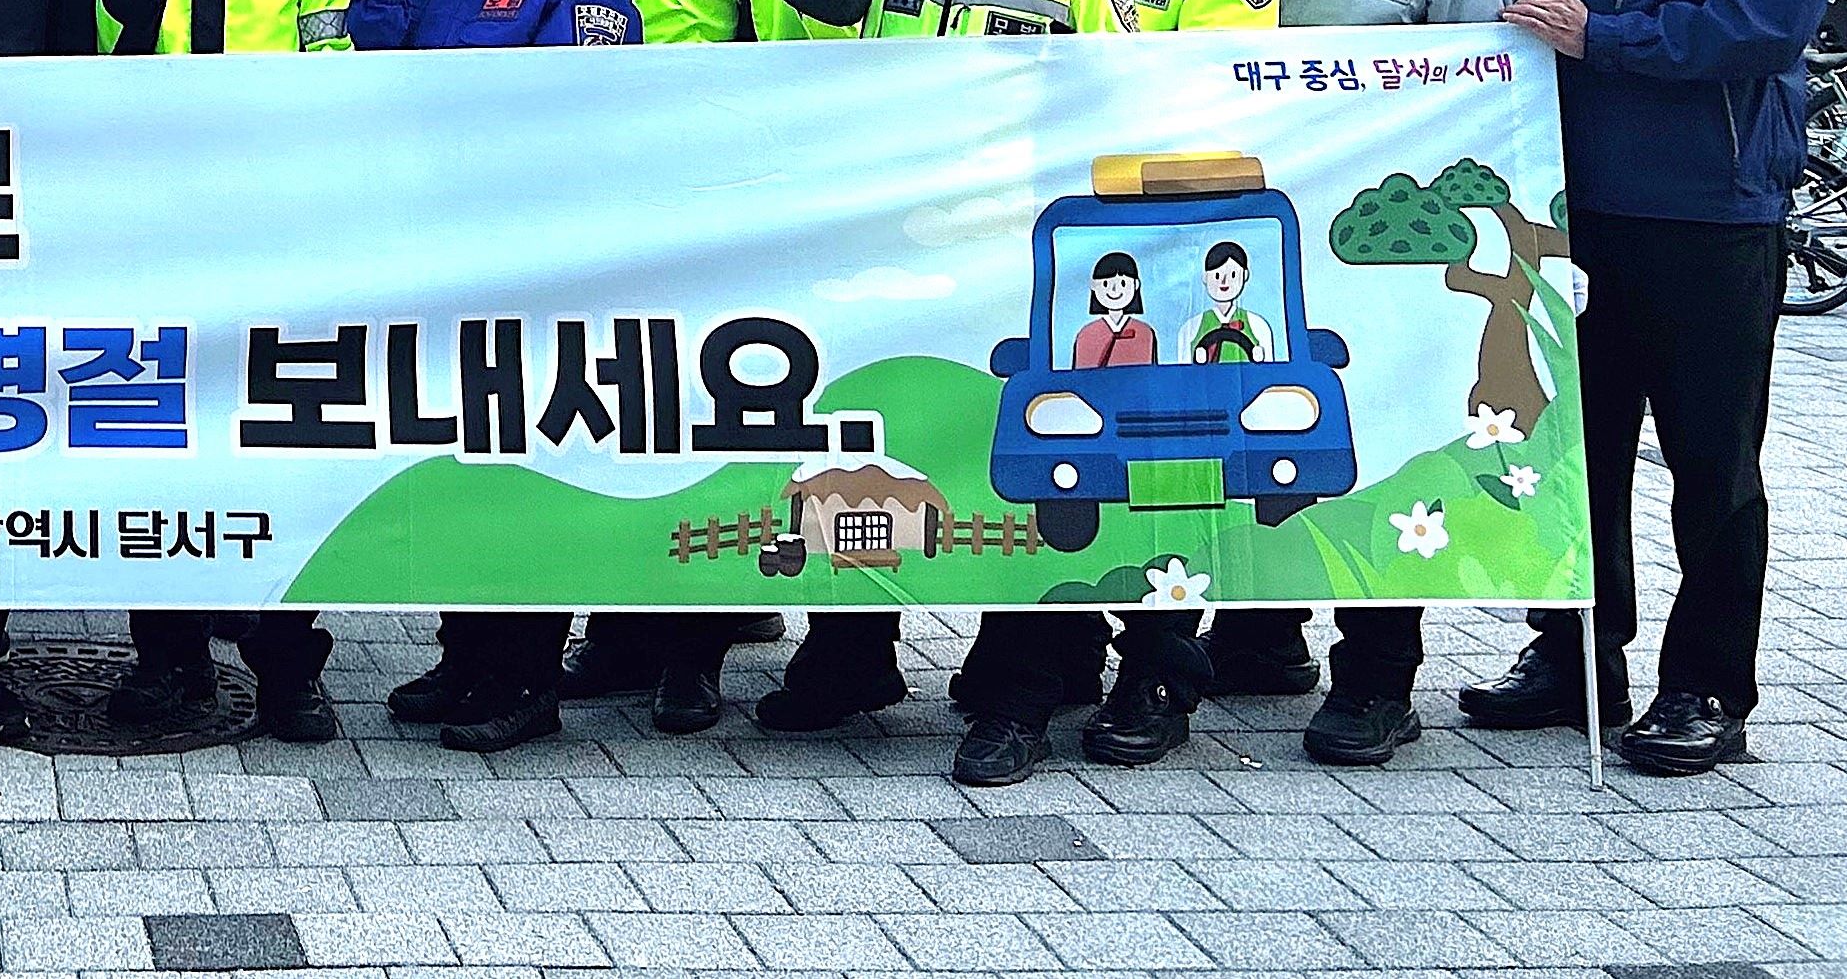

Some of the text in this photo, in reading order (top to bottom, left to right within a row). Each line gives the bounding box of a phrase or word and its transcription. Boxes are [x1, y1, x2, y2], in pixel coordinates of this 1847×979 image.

[1233, 53, 1513, 94] 대구 중심, 달서의 시대
[238, 316, 876, 455] 보내세요.
[116, 508, 274, 560] 달서구
